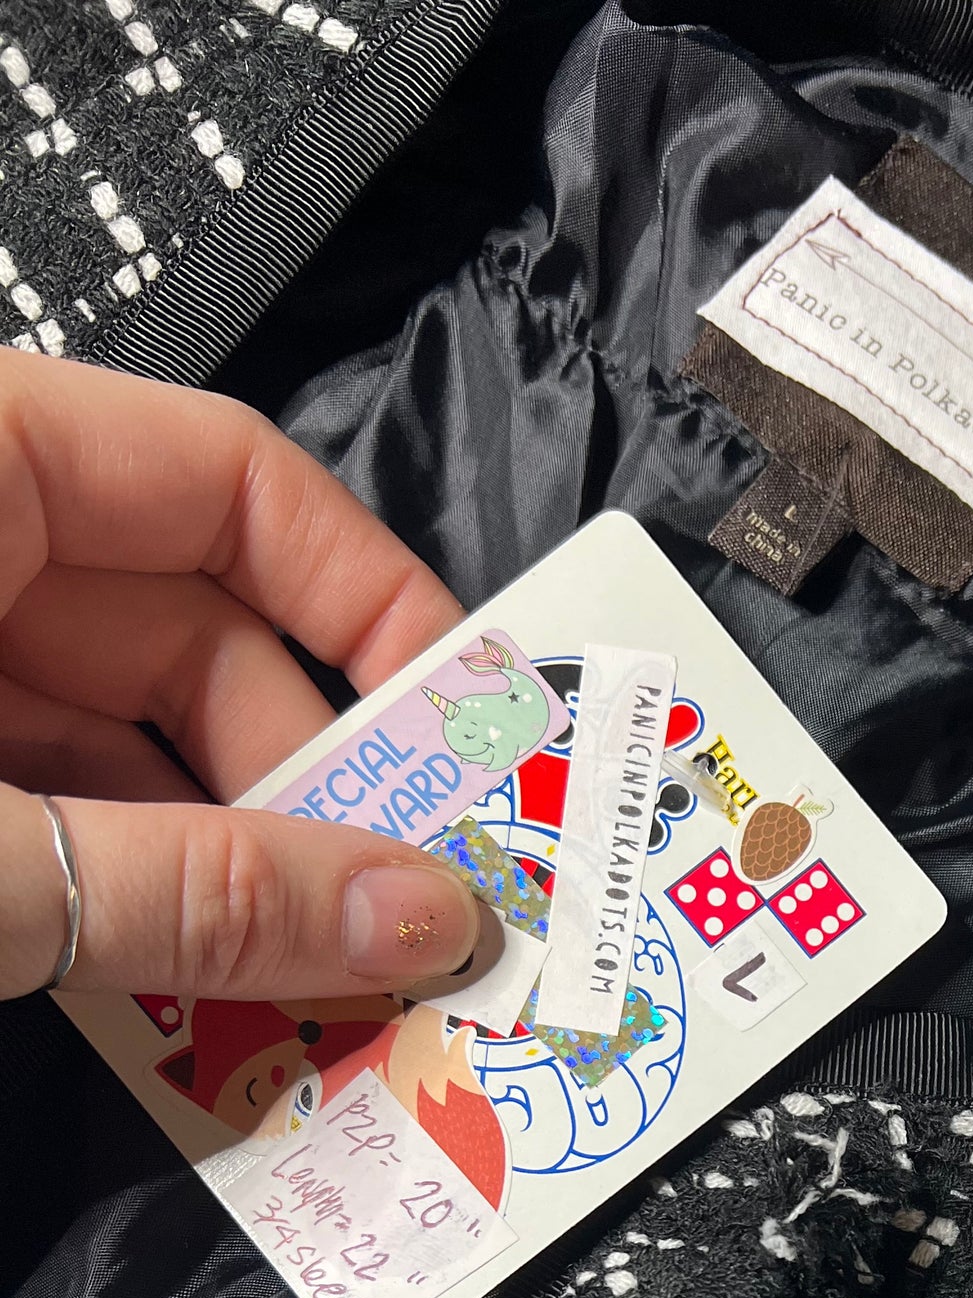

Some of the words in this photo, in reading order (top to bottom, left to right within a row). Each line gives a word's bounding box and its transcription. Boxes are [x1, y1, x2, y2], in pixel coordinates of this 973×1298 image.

[760, 267, 849, 333] Panic
[850, 325, 883, 357] in
[745, 511, 787, 544] made
[784, 504, 799, 524] L
[288, 728, 418, 823] ECIAL
[589, 683, 662, 996] PANICINPOLKADOTS.COM
